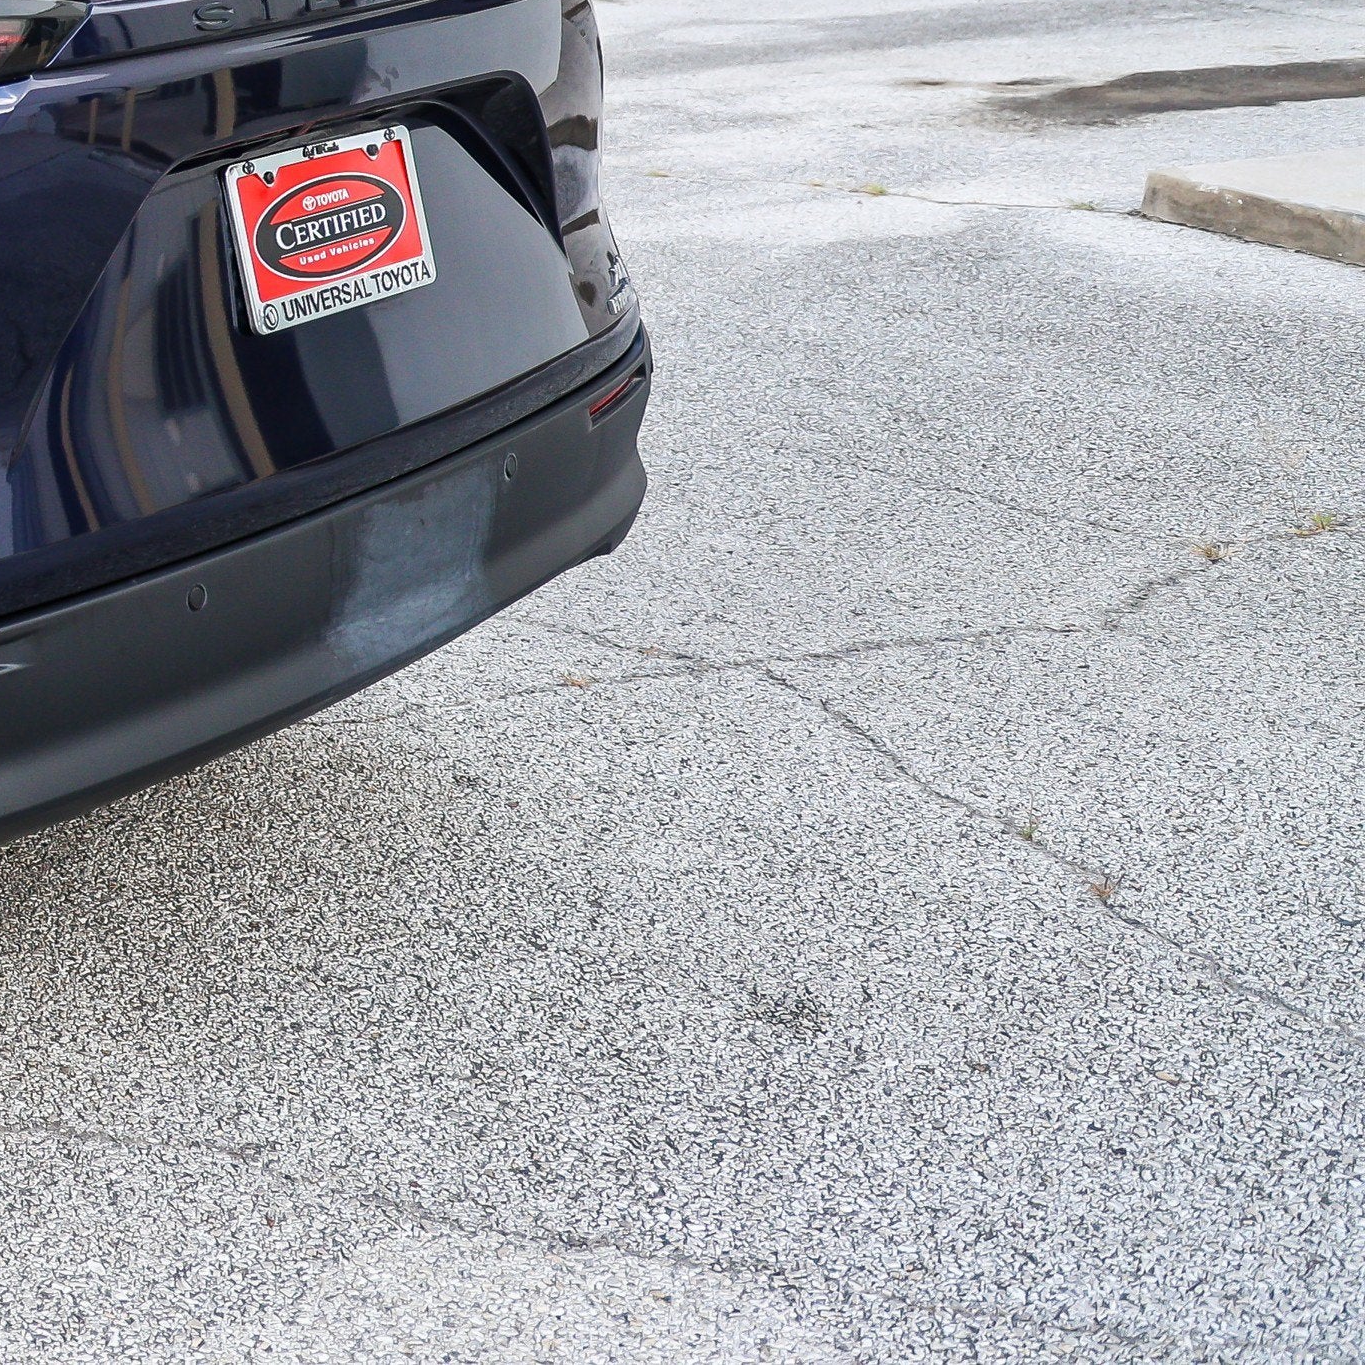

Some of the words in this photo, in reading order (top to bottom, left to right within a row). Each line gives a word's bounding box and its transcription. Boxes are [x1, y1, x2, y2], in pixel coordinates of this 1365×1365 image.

[315, 188, 350, 206] TOYOTA
[275, 202, 387, 250] CERTIFIED
[299, 250, 327, 266] Used
[329, 237, 376, 257] Vehicles
[281, 280, 373, 323] UNIVERSAL
[375, 261, 432, 295] TOYOTA
